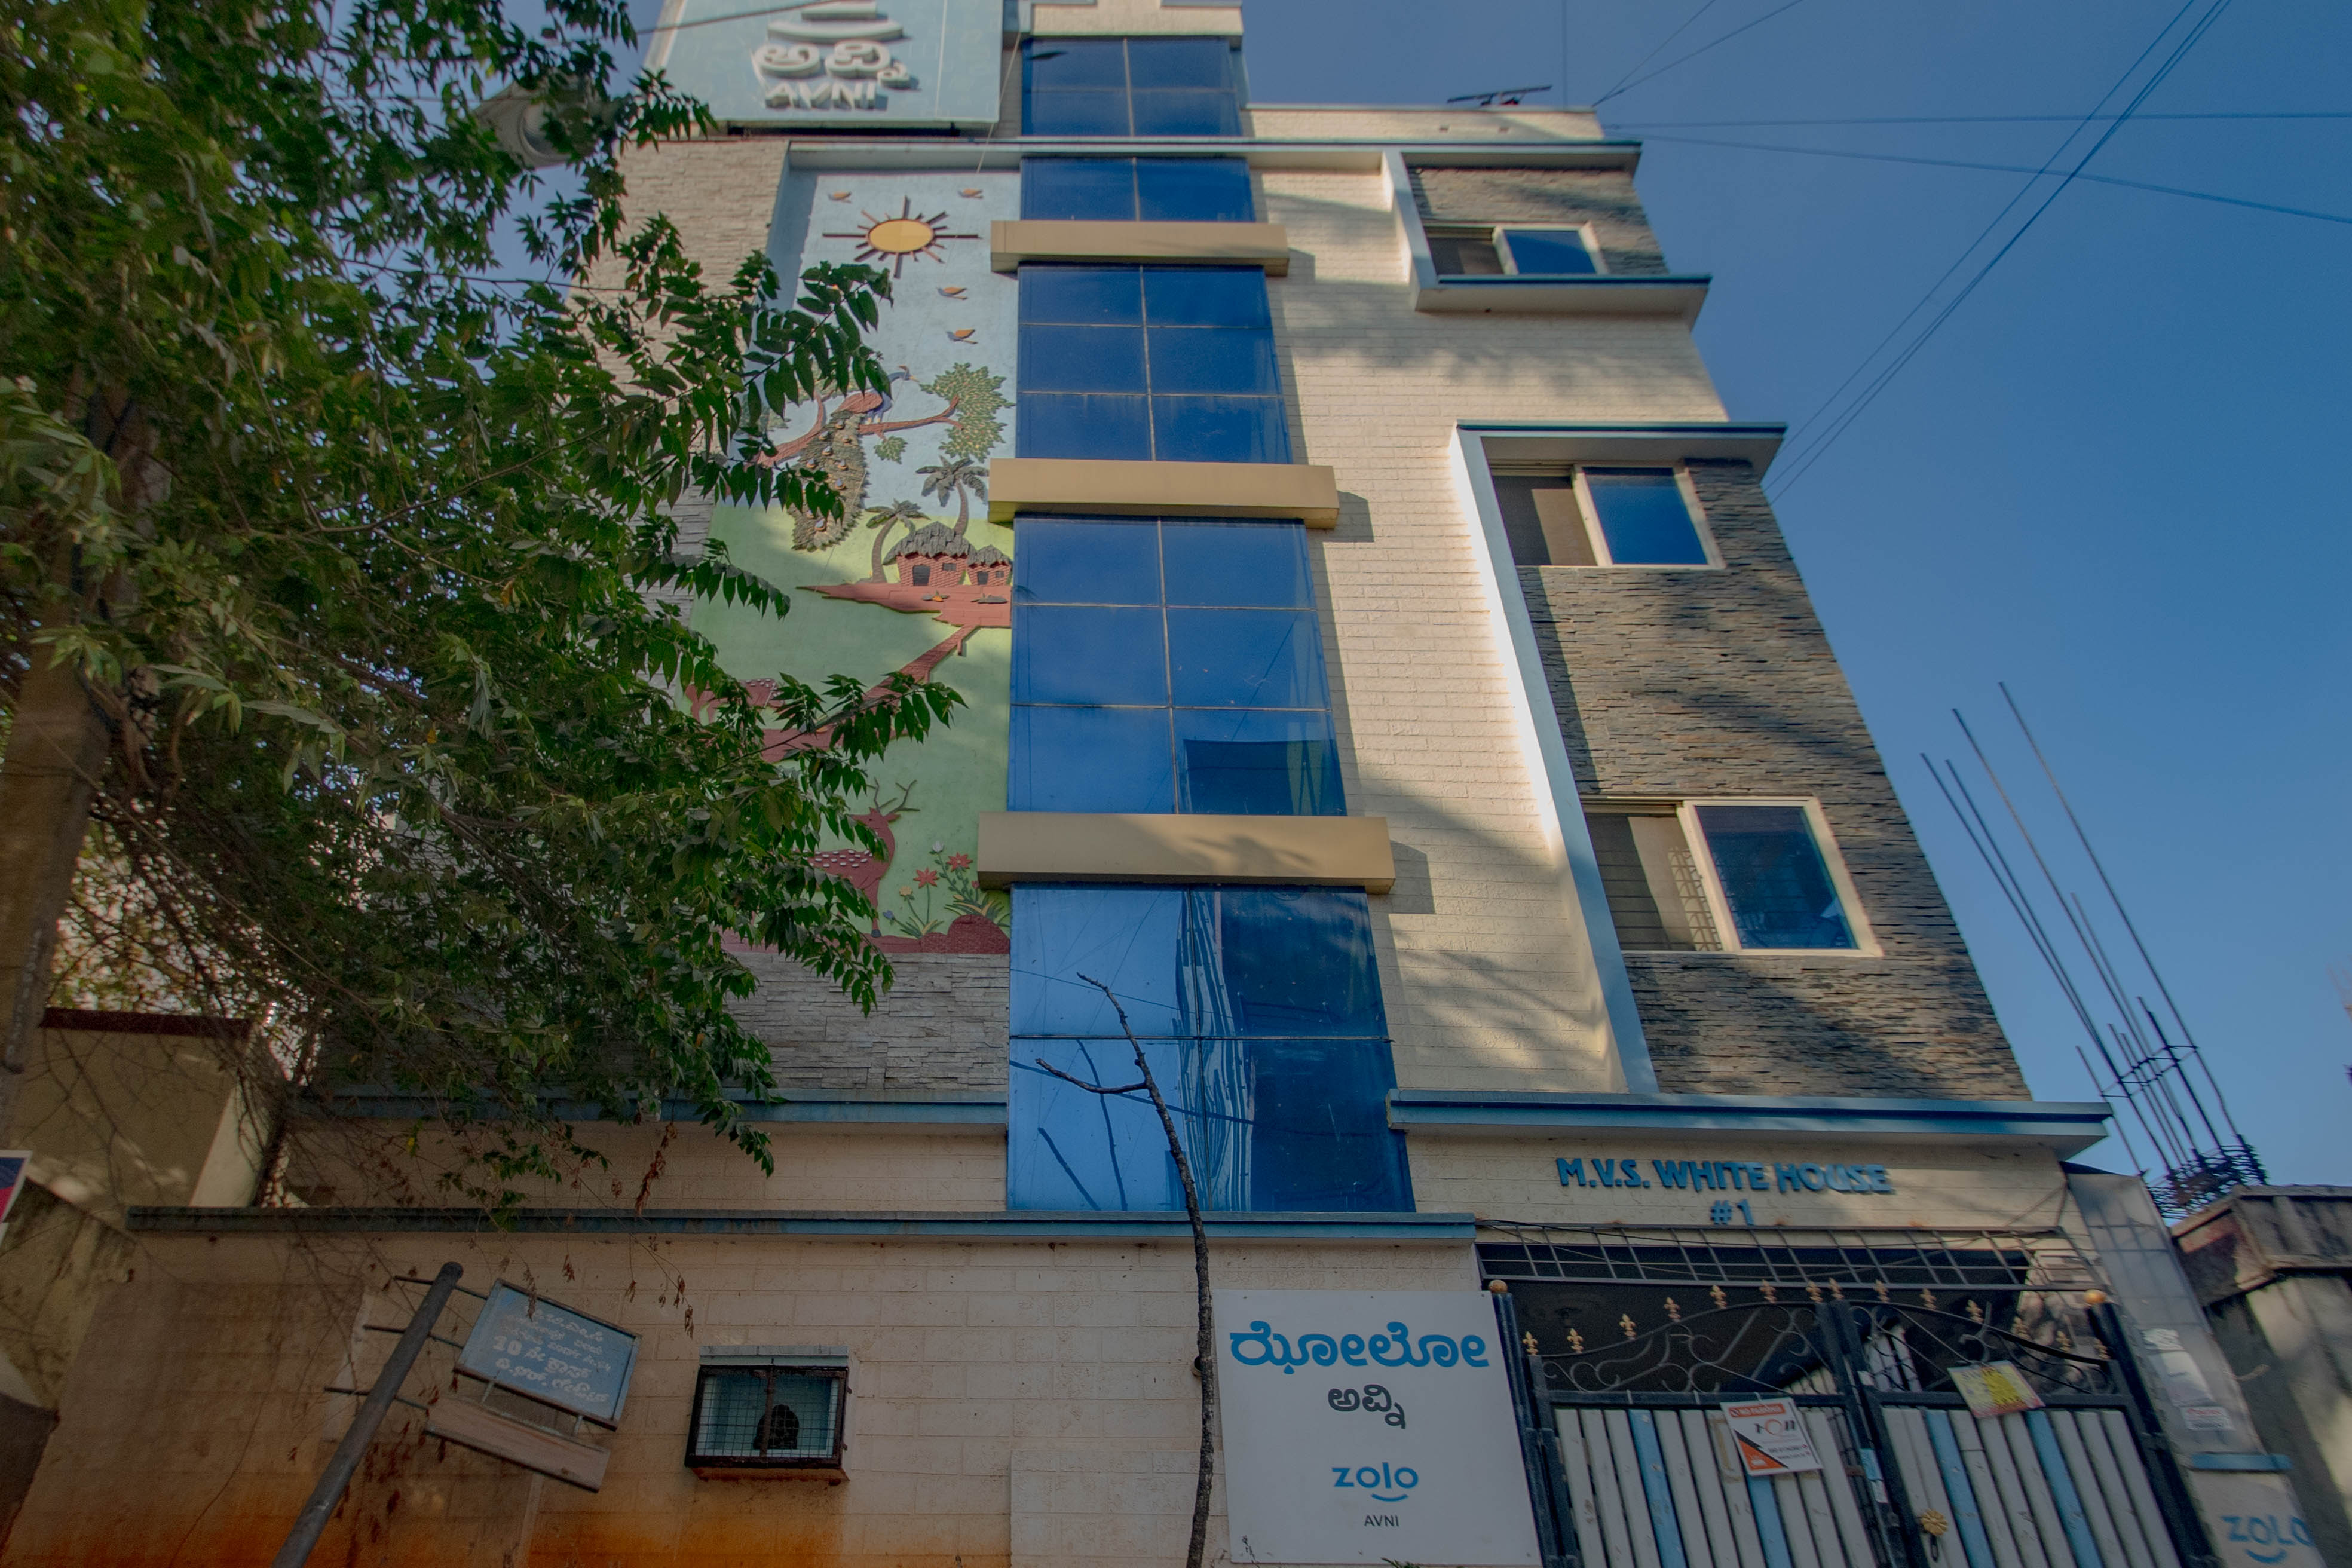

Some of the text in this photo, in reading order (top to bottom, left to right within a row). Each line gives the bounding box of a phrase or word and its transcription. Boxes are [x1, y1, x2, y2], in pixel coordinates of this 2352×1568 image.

[765, 82, 878, 110] AVNI
[1557, 1158, 1891, 1193] M.V.S. WHITE HOUSE
[1229, 1320, 1490, 1375] ಝೋಲೋ
[1328, 1383, 1406, 1430] ಅವ್ನಿ
[1331, 1462, 1419, 1489] zolo
[1364, 1515, 1399, 1527] AVNI
